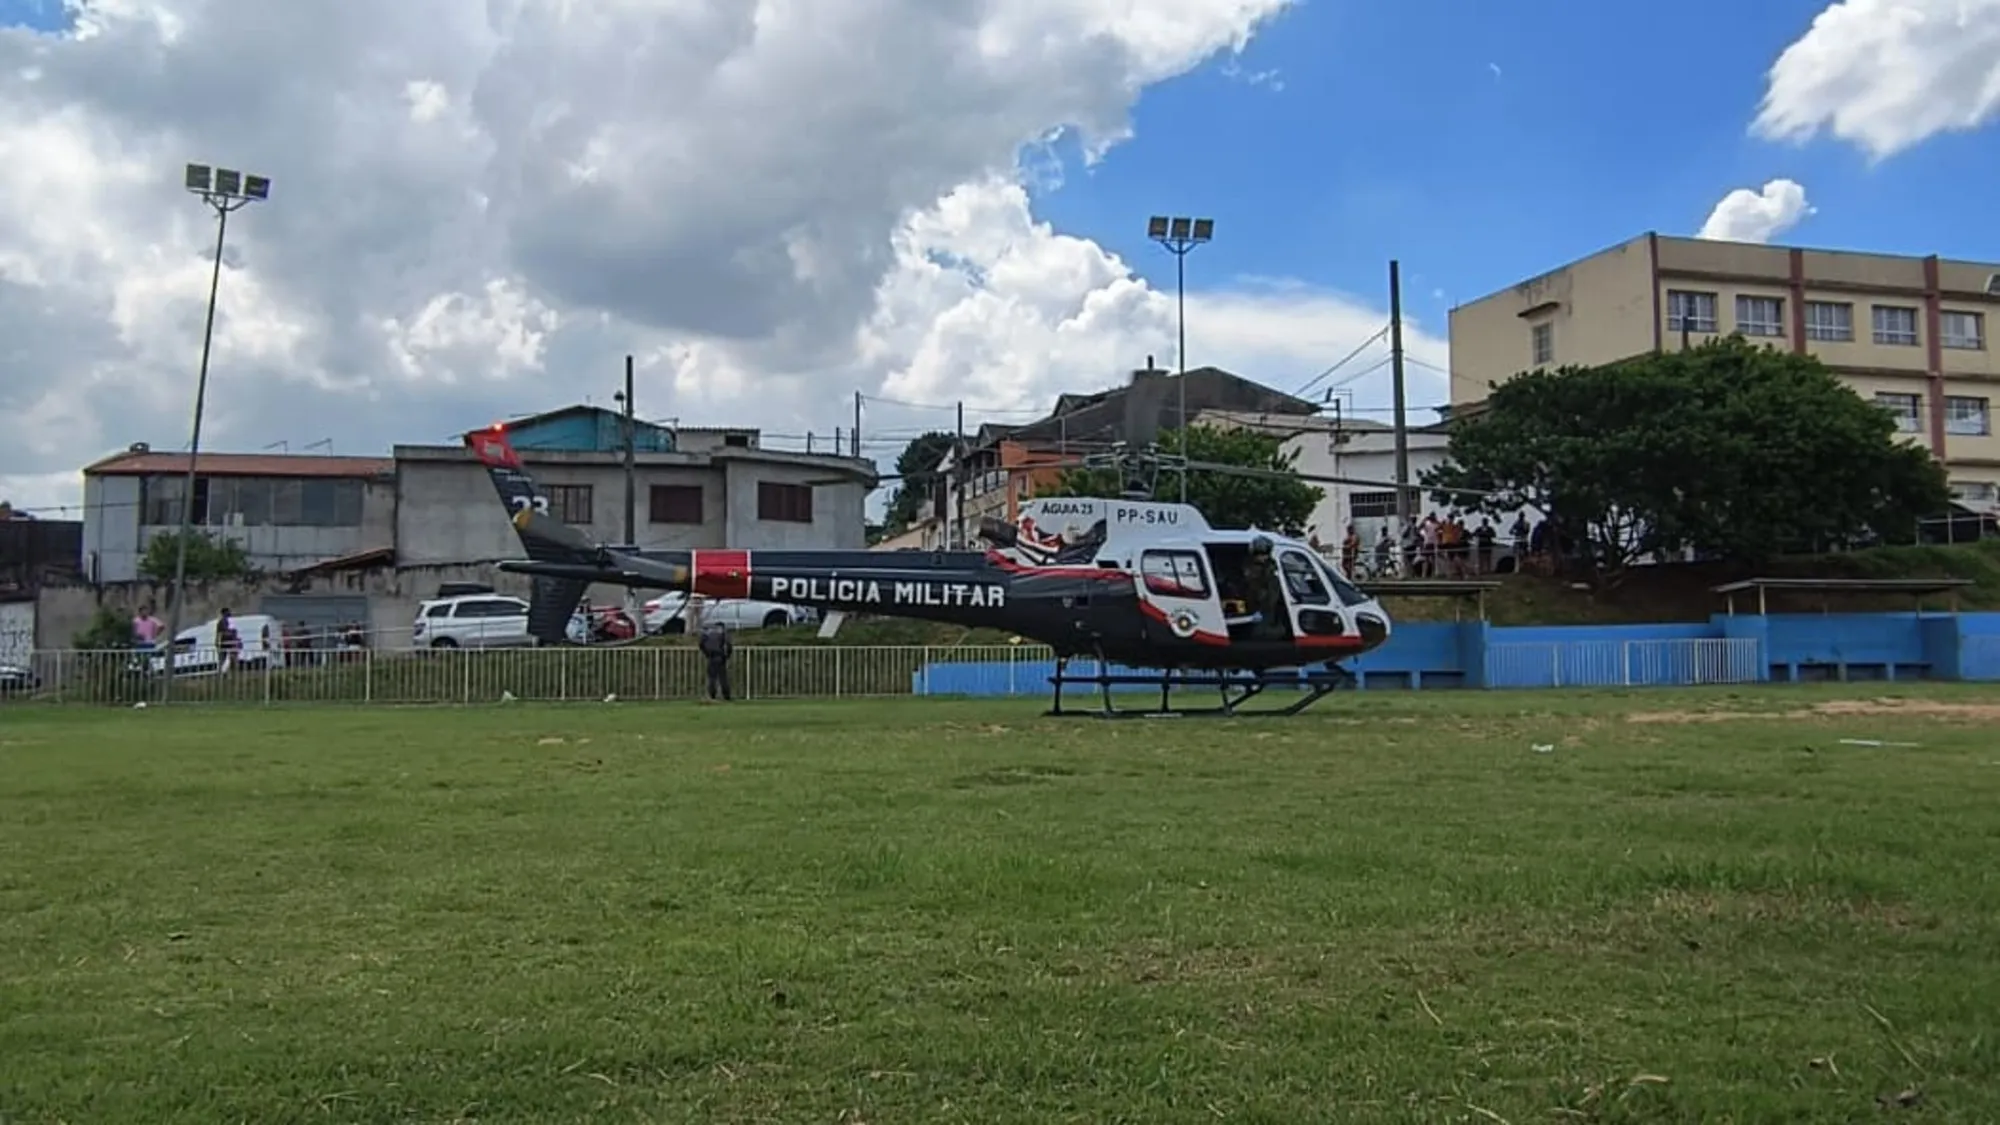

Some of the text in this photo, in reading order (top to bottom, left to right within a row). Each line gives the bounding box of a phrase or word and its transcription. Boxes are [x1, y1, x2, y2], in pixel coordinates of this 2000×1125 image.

[1117, 508, 1178, 525] PP-SAU
[771, 572, 1004, 607] POLÍCIA MILITAR
